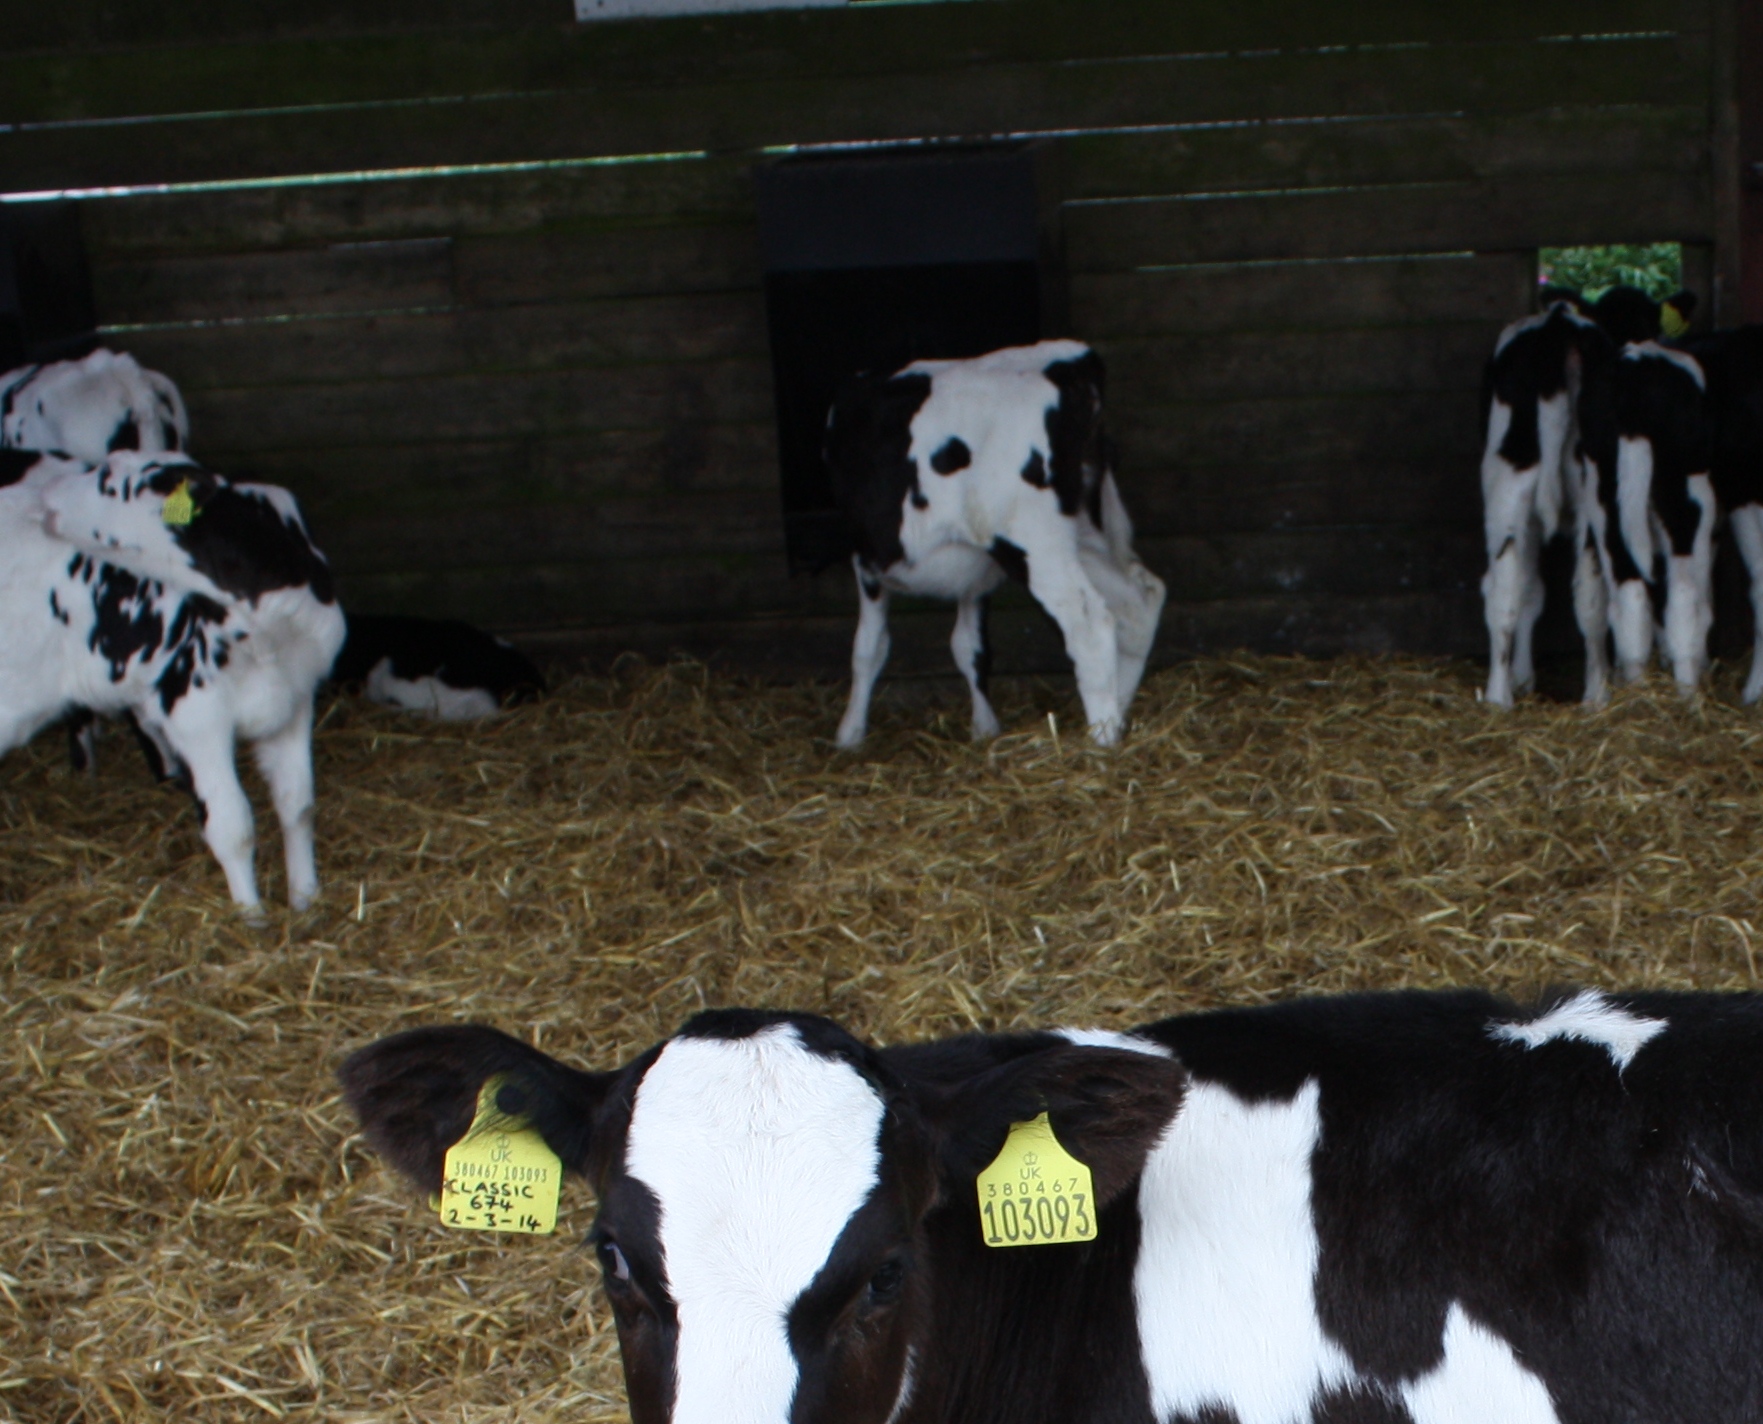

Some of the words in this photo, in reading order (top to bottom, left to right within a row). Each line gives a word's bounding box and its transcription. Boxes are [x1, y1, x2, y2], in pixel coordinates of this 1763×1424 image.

[491, 1150, 512, 1162] UK
[455, 1162, 498, 1177] 380467
[504, 1164, 547, 1182] 103093
[1020, 1167, 1042, 1179] UK
[449, 1178, 534, 1198] CLASSIC
[987, 1178, 1078, 1197] 380467
[470, 1196, 514, 1213] 674
[984, 1194, 1089, 1242] 103093
